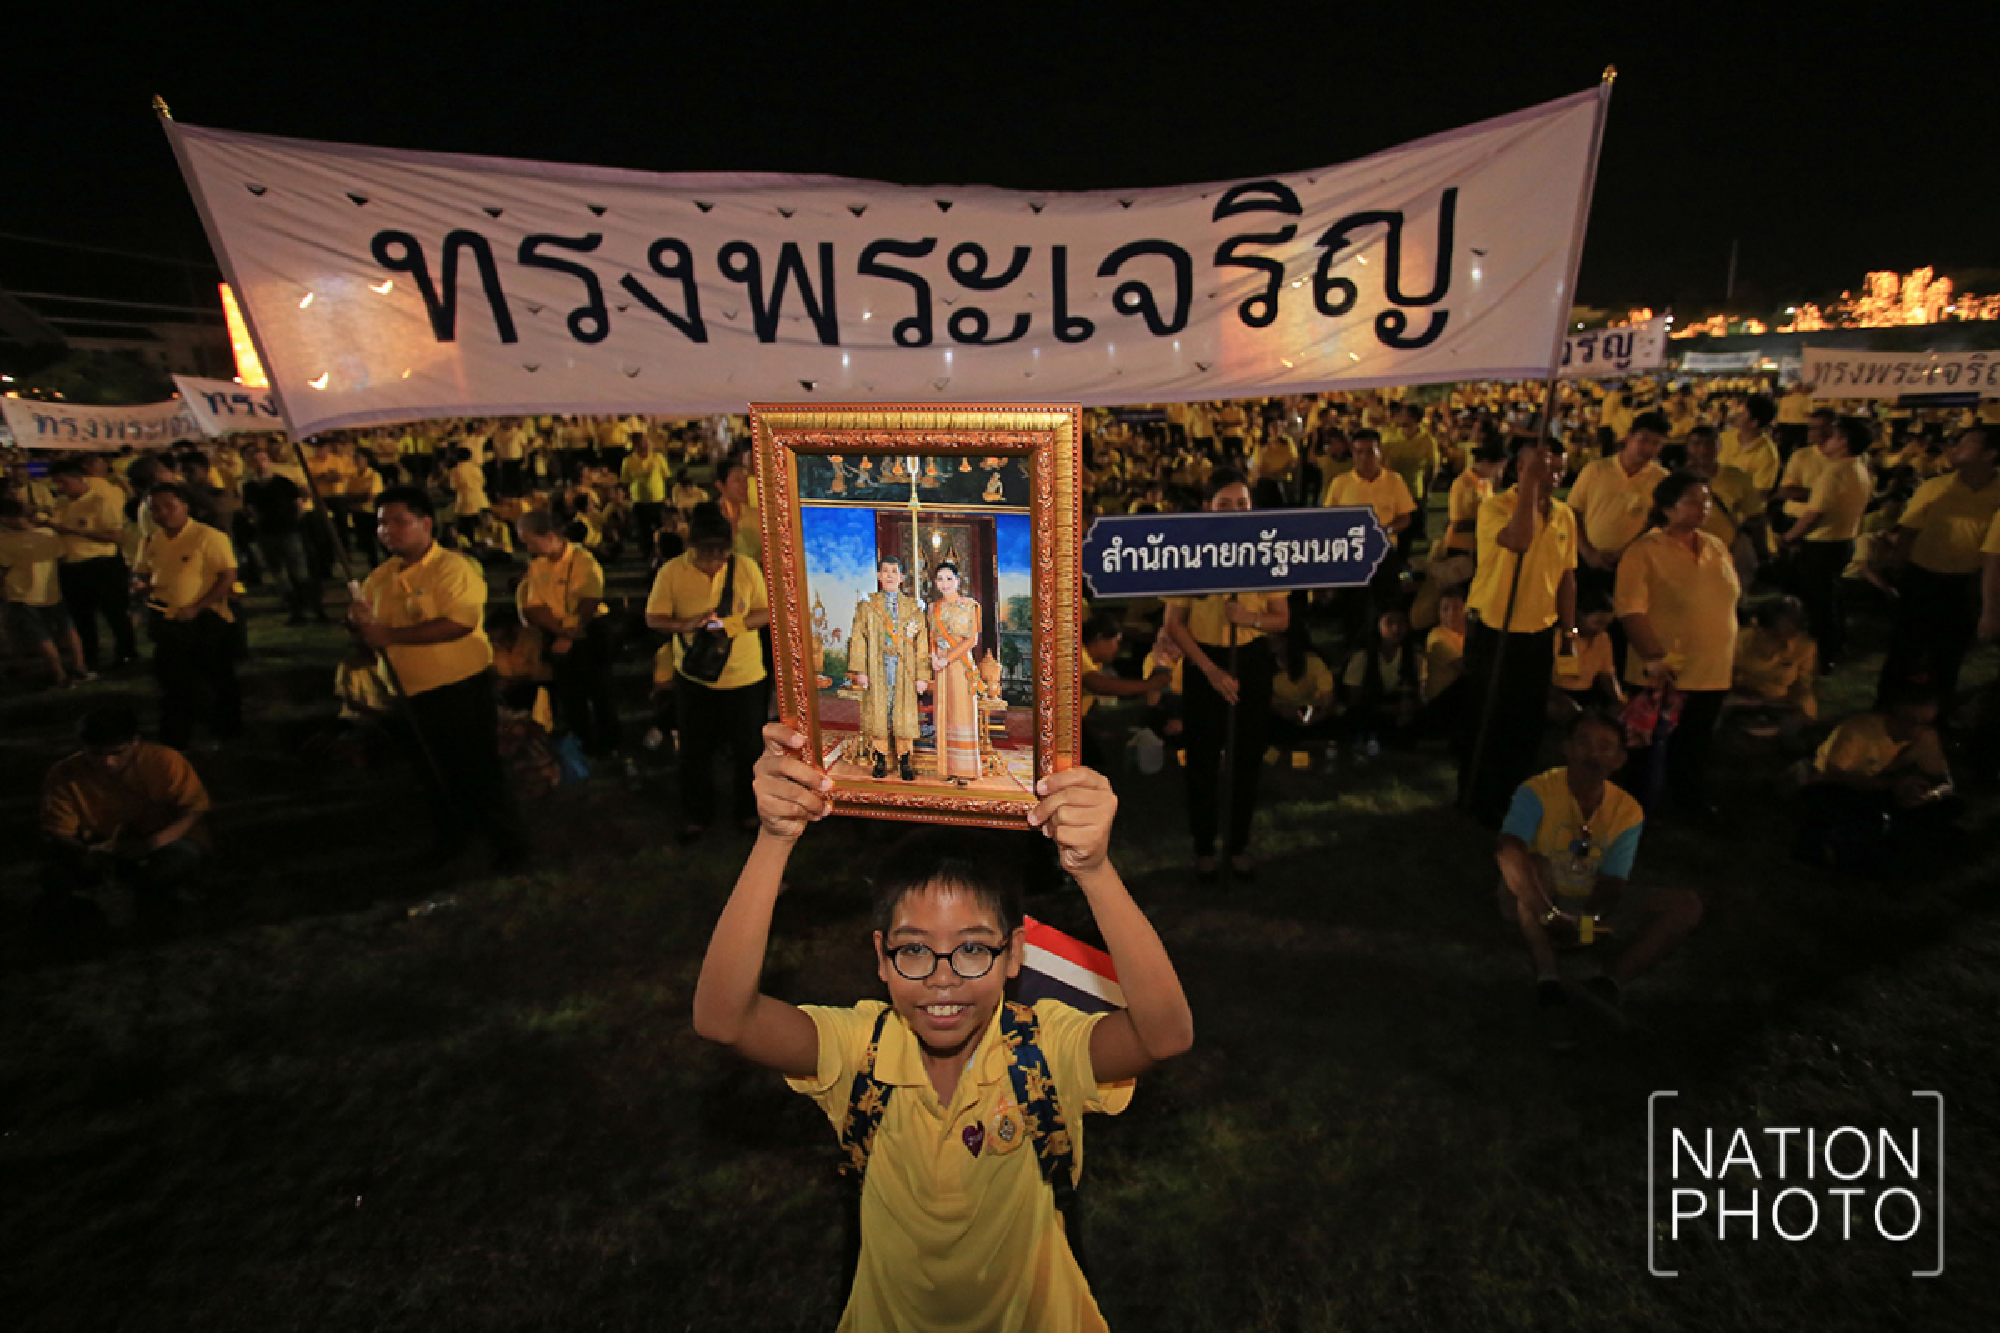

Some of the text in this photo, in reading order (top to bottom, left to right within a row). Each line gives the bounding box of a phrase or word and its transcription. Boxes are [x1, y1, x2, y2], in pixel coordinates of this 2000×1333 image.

[370, 180, 1458, 349] ทรงพระเจริญ
[1102, 525, 1366, 577] สำนักนายกรัฐมนตรี
